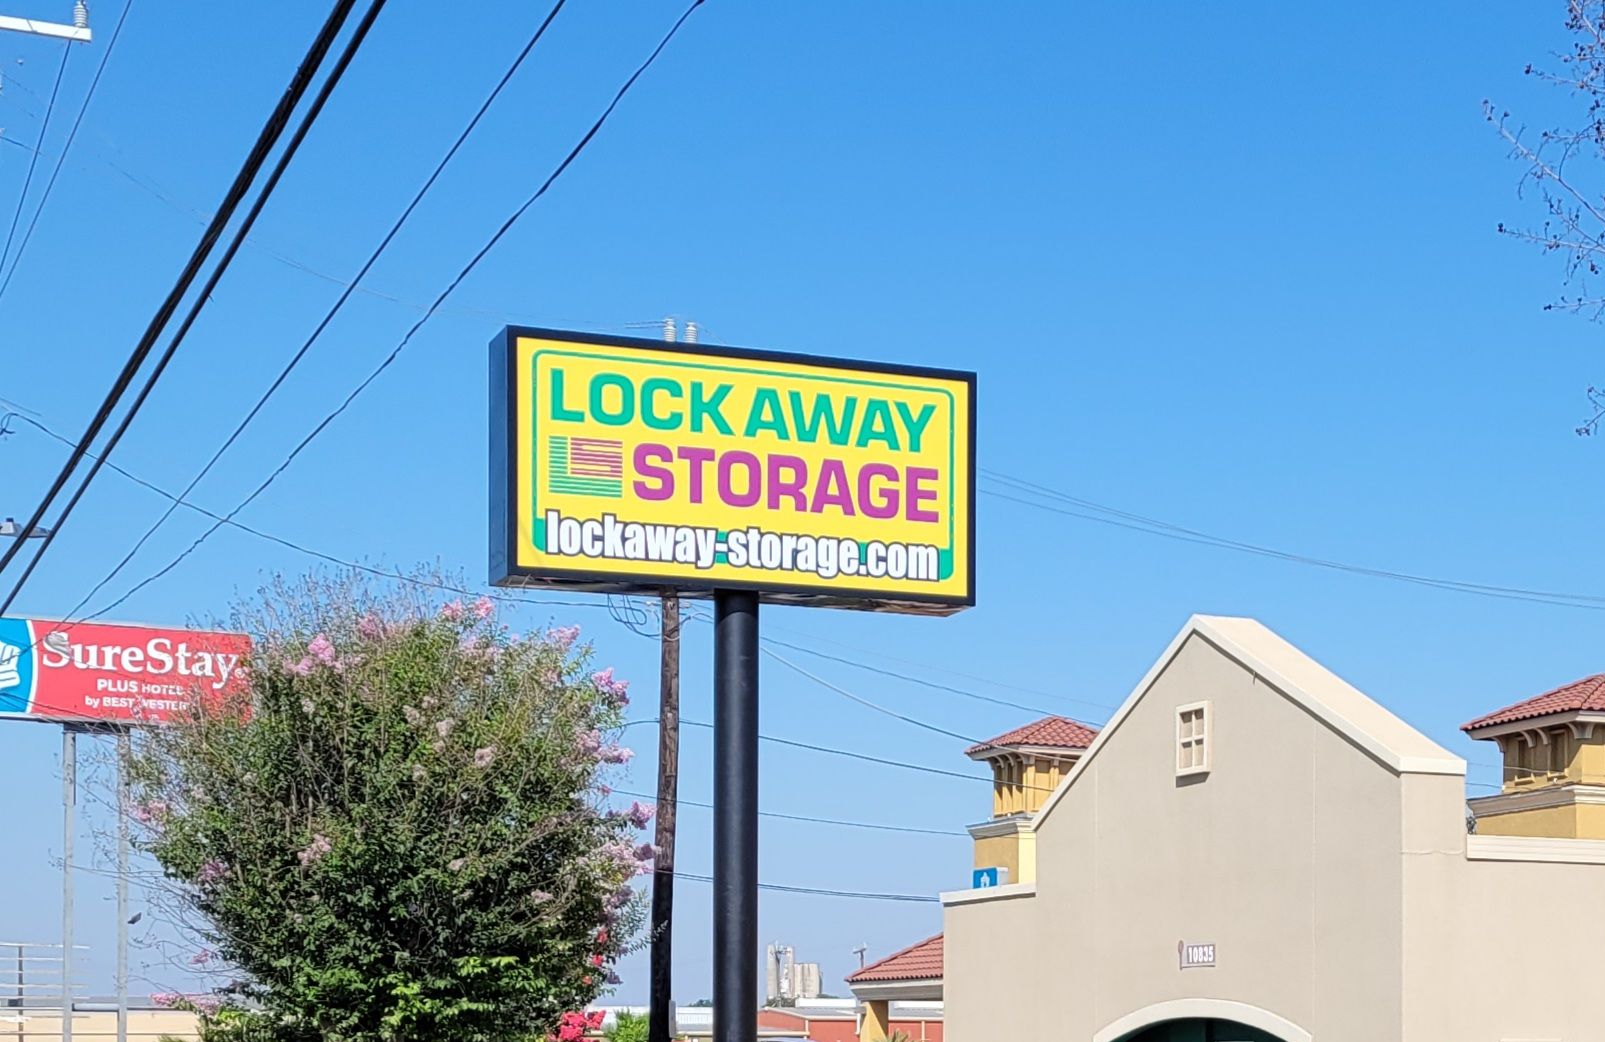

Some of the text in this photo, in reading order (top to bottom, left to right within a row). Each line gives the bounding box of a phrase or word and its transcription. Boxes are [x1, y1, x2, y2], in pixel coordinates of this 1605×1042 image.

[632, 443, 939, 523] STORAGE
[545, 509, 940, 582] lockaway-storage.com
[42, 631, 239, 689] SureStay
[85, 695, 100, 708] by
[103, 696, 135, 708] BEST
[97, 678, 138, 692] PLUS
[1188, 945, 1214, 963] 10835
